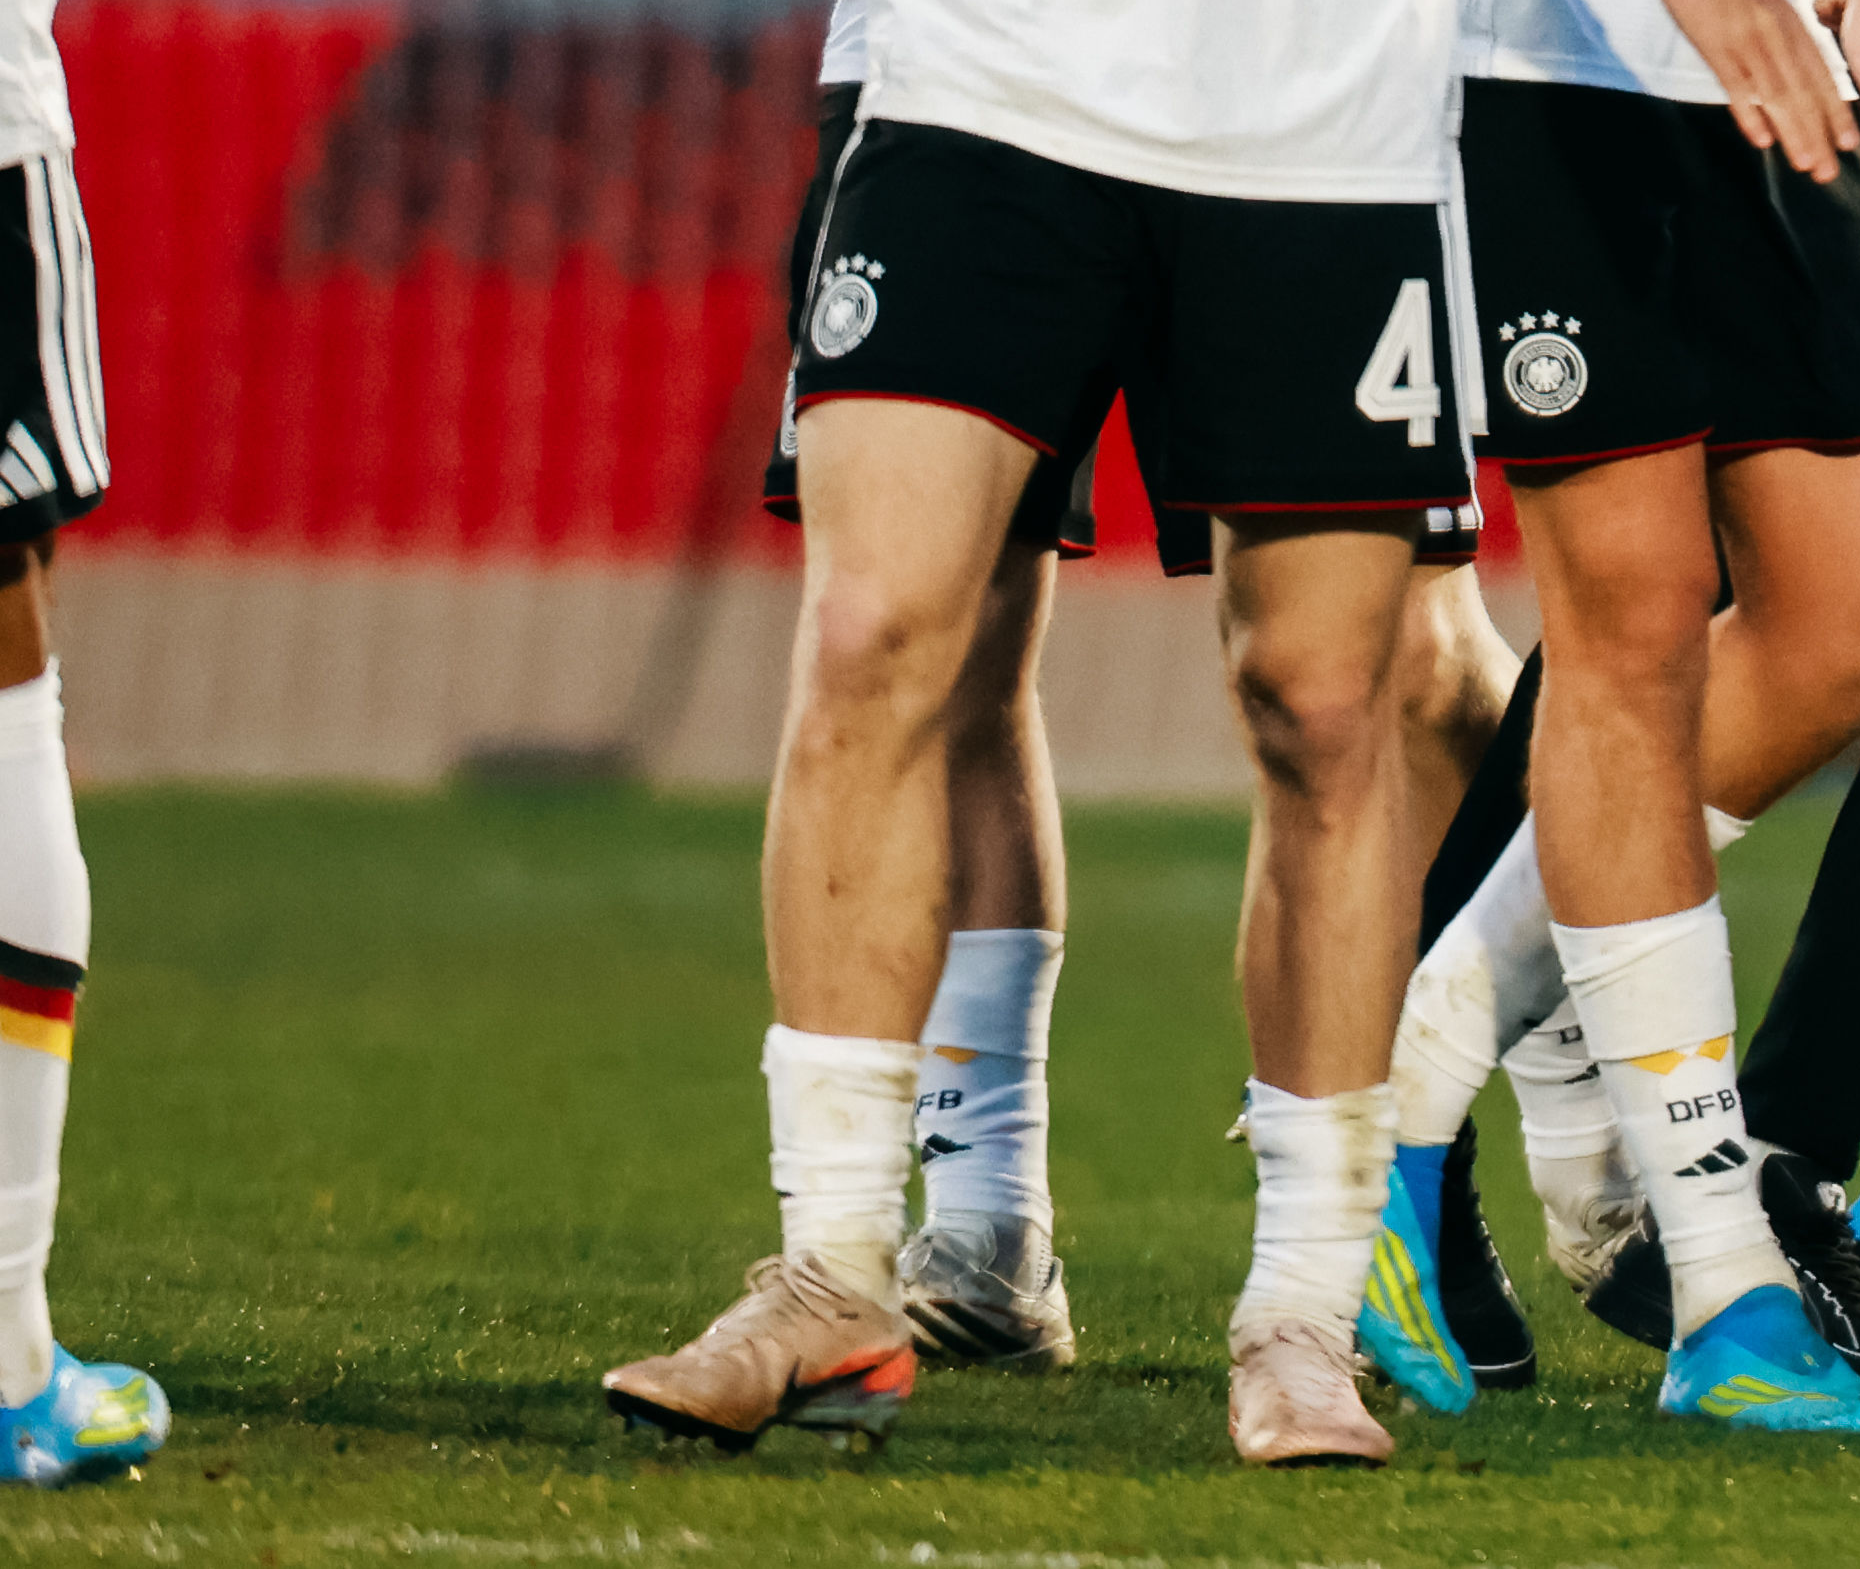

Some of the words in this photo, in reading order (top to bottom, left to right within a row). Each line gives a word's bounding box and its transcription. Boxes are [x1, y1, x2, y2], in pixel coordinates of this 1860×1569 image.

[1355, 278, 1441, 447] 4
[916, 1089, 963, 1115] FB
[1666, 1089, 1737, 1123] DFB
